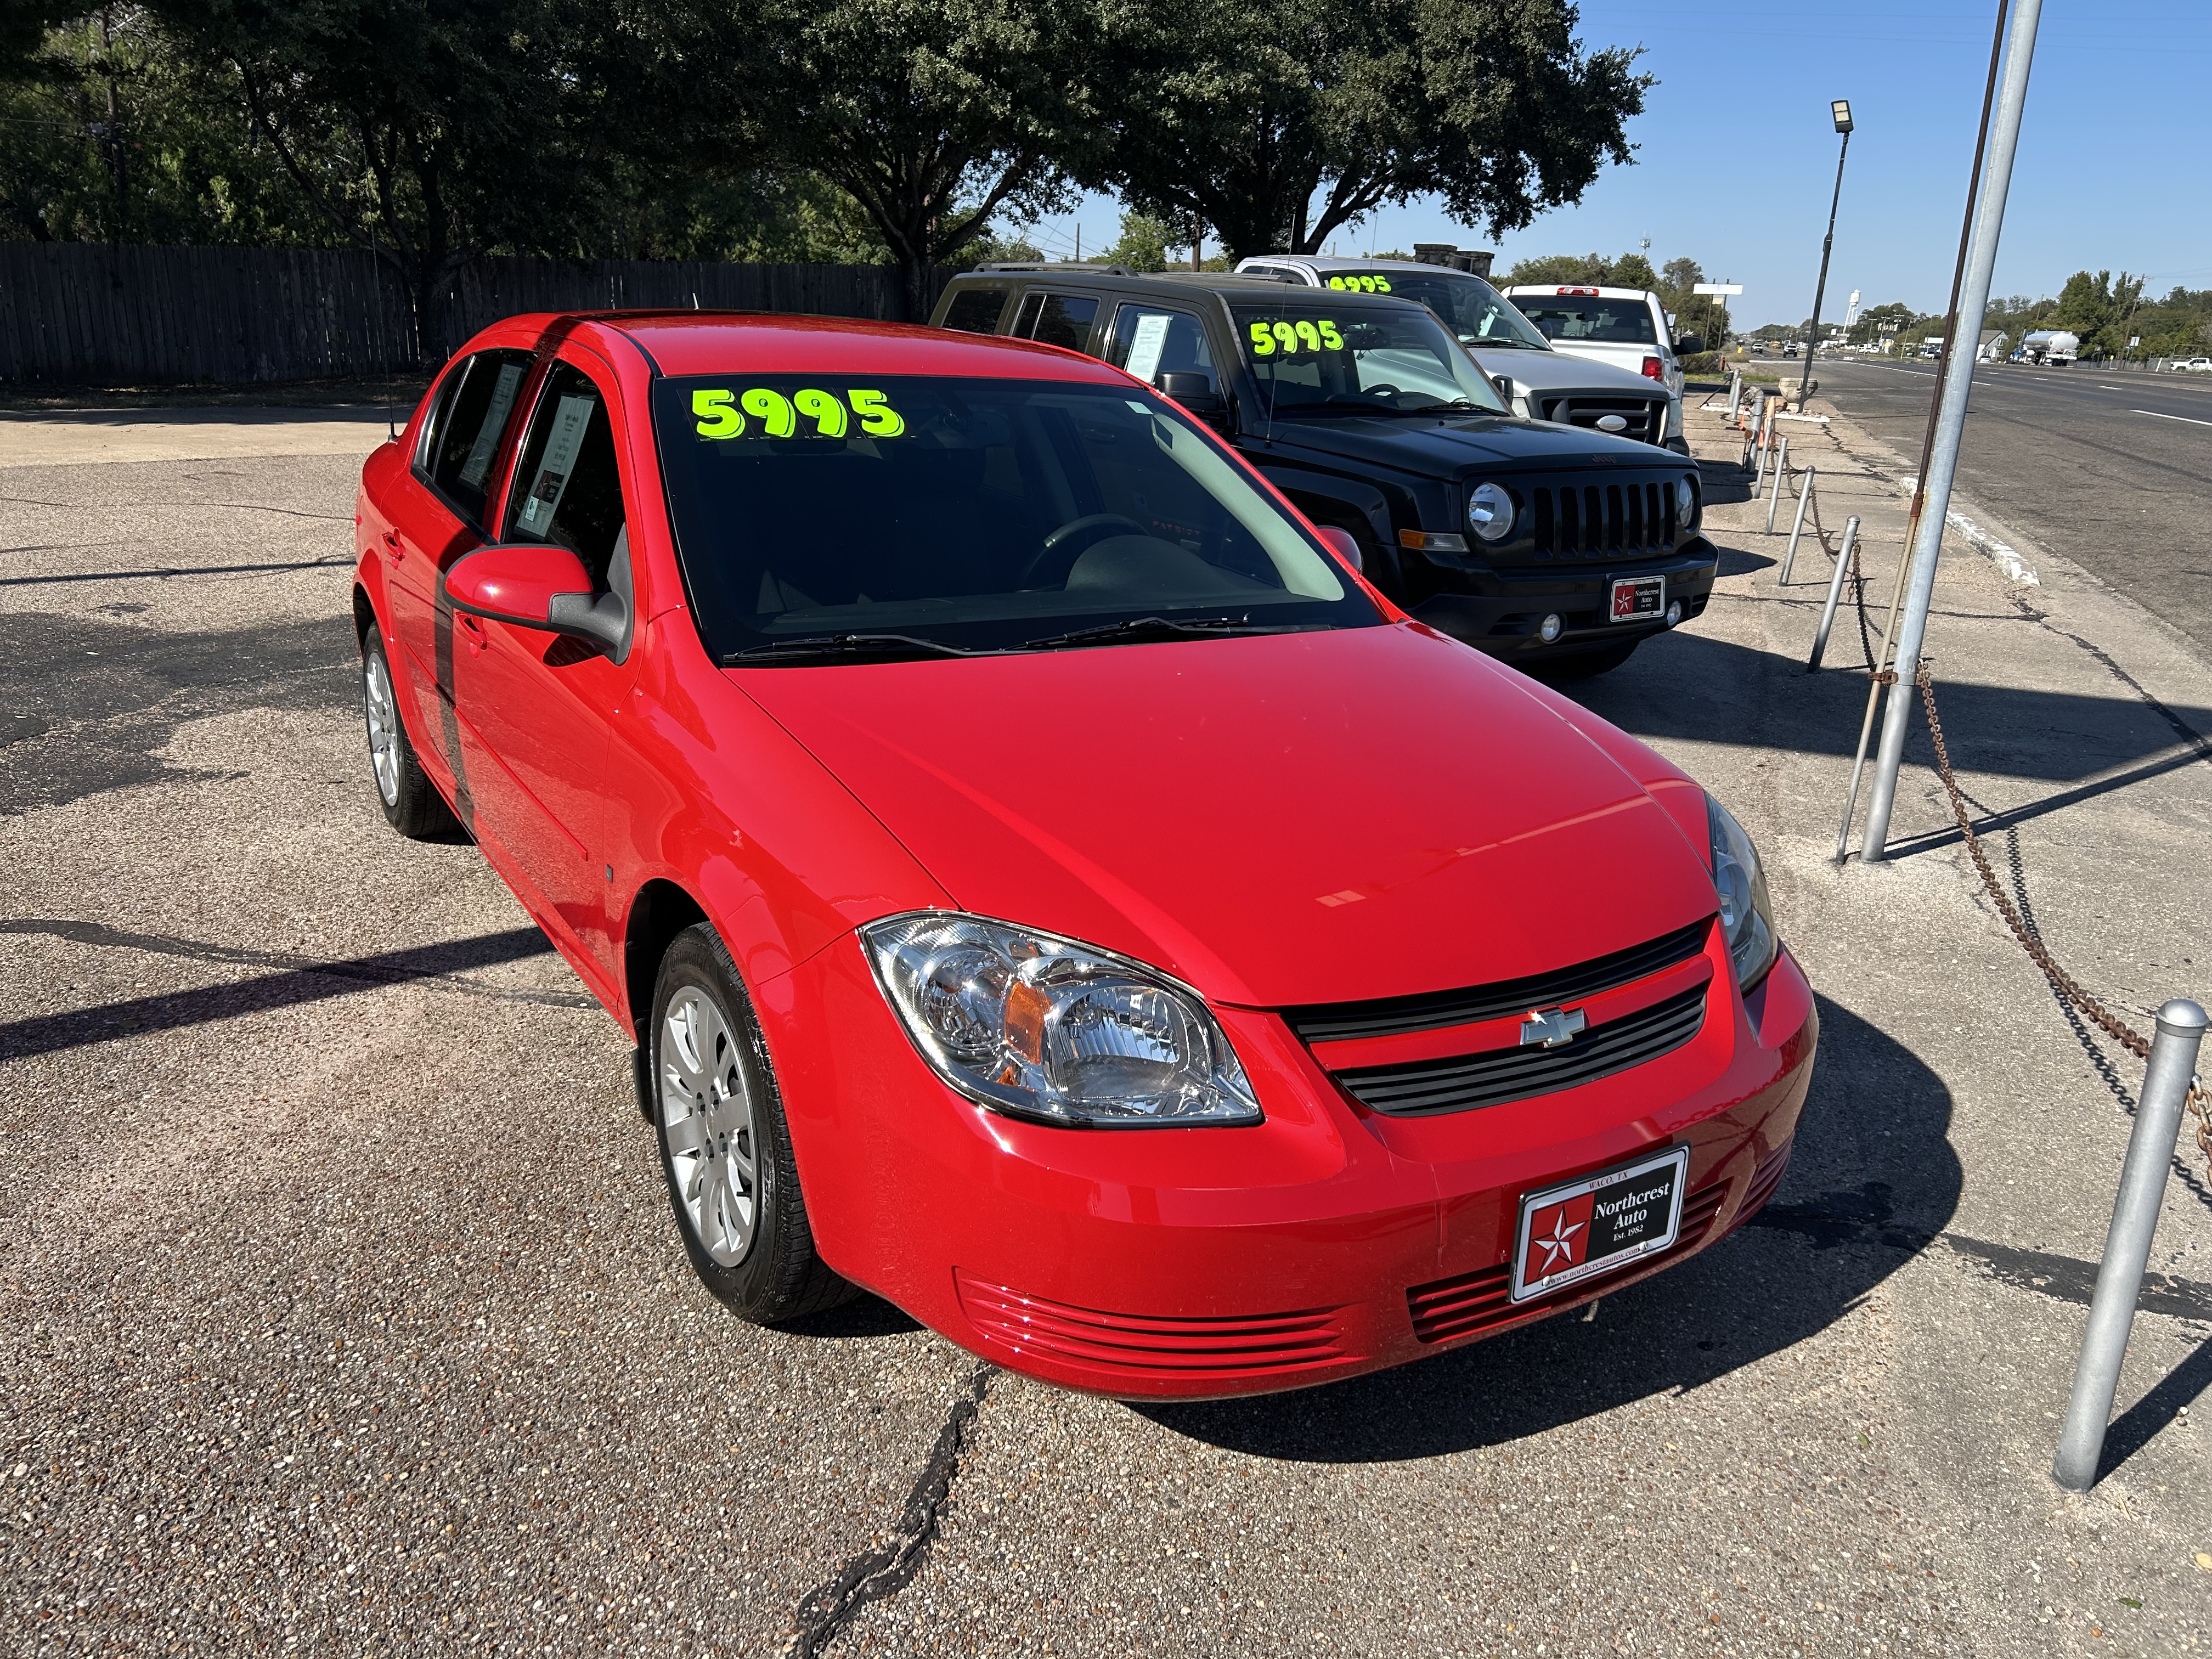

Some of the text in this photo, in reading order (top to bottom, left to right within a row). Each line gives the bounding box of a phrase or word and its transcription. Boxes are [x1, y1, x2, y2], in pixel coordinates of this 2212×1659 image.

[1250, 320, 1344, 356] 5995
[692, 388, 905, 439] 5995
[1592, 454, 1617, 465] Jeep
[1153, 520, 1201, 535] PATRIOT
[1635, 589, 1660, 597] Northcrest
[669, 947, 707, 973] Continental
[1589, 1170, 1629, 1189] WACO, TX
[1594, 1182, 1670, 1219] Northcrest
[1613, 1209, 1647, 1229] Auto
[1613, 1224, 1644, 1242] Est. 1982
